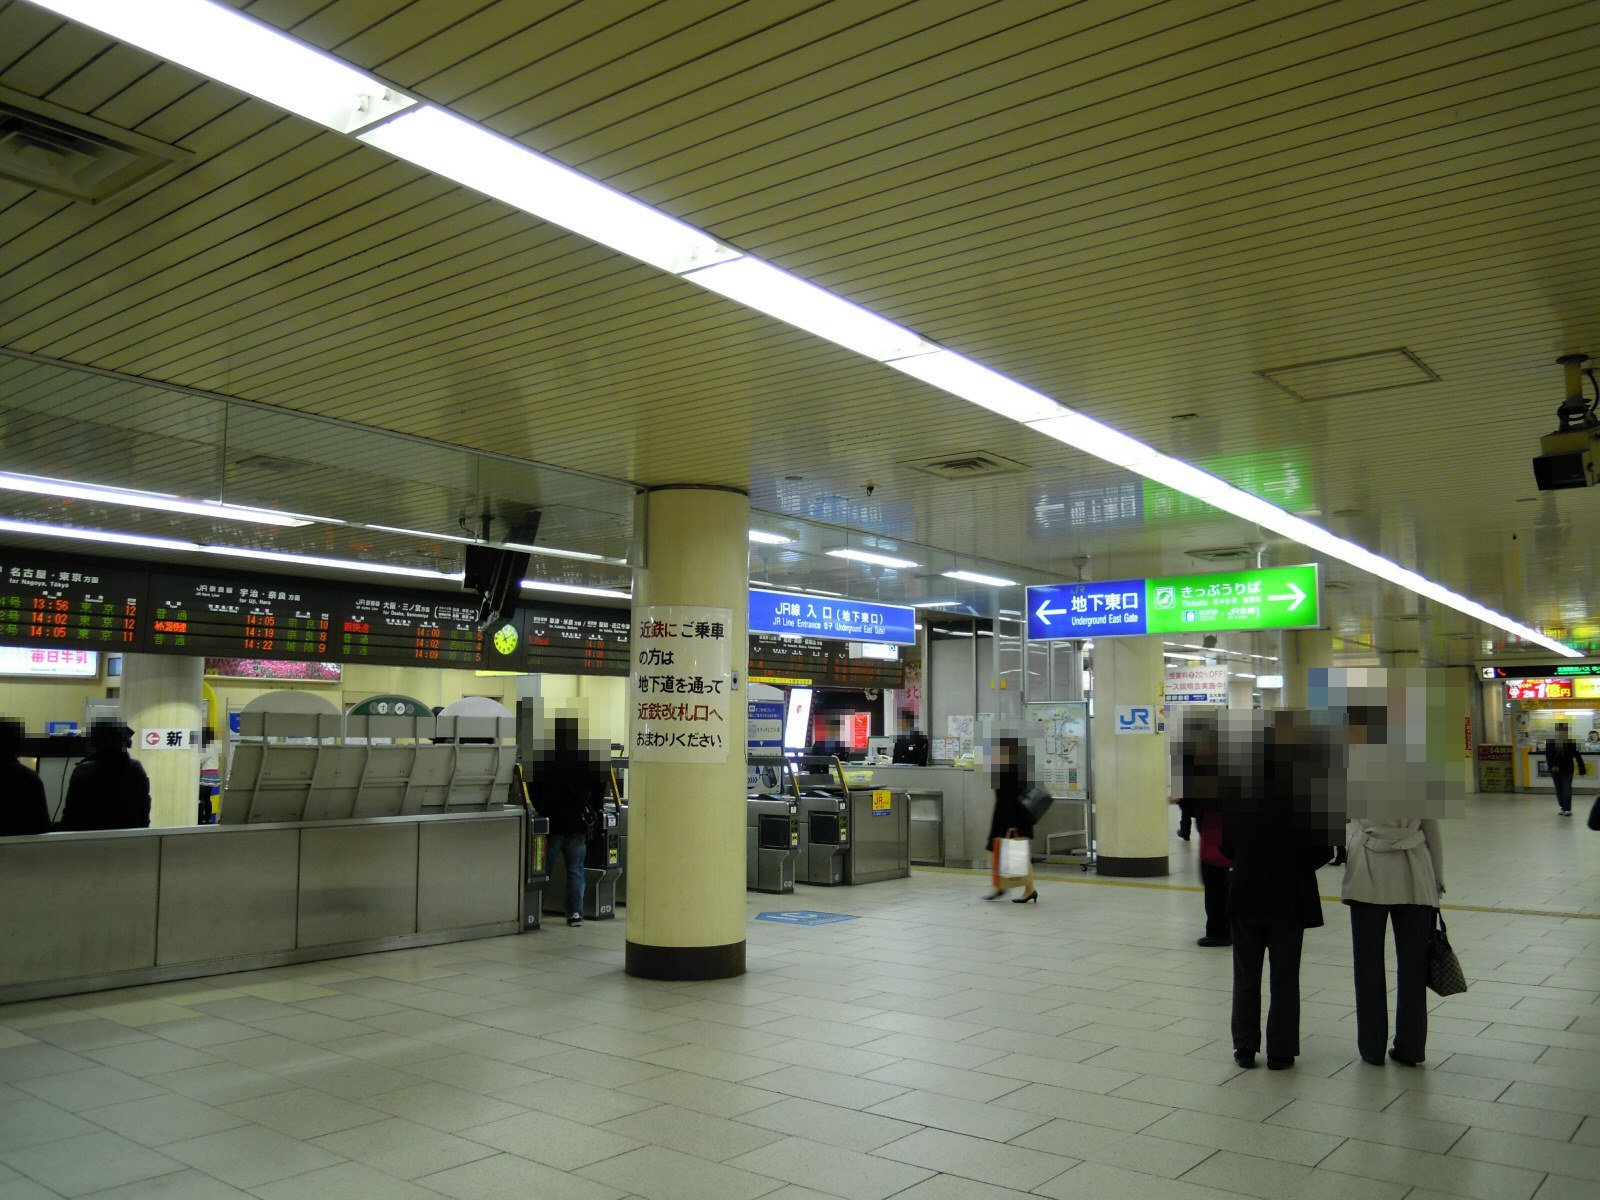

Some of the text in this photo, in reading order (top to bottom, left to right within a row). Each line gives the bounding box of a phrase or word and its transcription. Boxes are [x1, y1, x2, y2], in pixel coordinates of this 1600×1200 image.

[1181, 581, 1261, 598] きっぷうりば
[125, 605, 136, 616] 12
[775, 602, 800, 616] JR線
[1071, 592, 1138, 612] 地下東口
[32, 611, 68, 625] 14:02
[124, 618, 135, 629] 12
[246, 615, 275, 626] 14:05
[320, 620, 328, 630] 10
[773, 617, 780, 625] JR
[782, 618, 794, 626] Line
[797, 619, 821, 630] Entrance
[864, 625, 872, 634] East
[1072, 613, 1138, 627] Underground East Gate
[31, 625, 67, 638] 14:05
[123, 631, 133, 642] 11
[320, 631, 327, 642] 8
[244, 640, 273, 650] 14:22
[318, 643, 326, 653] 9
[31, 650, 88, 664] 毎日牛乳
[639, 648, 674, 666] の方は
[638, 675, 723, 694] 地下道を通って
[638, 703, 724, 721] 近鉄改札口へ
[1120, 708, 1149, 725] JR
[874, 796, 883, 805] JR
